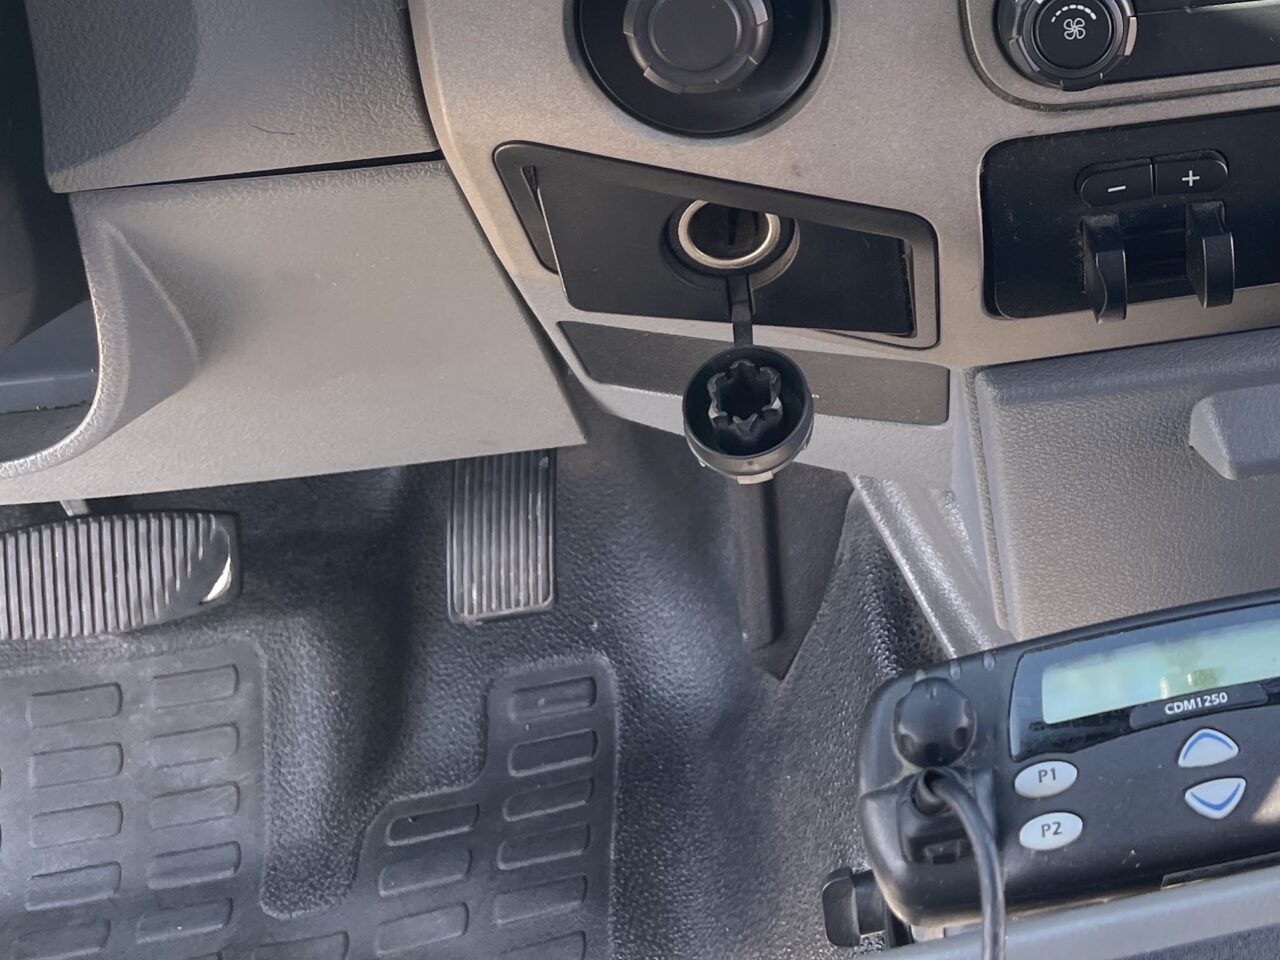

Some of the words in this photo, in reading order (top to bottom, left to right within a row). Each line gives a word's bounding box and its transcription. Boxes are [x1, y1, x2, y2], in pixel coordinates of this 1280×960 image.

[1164, 691, 1228, 715] CDM1250
[1038, 767, 1057, 783] P1
[1041, 821, 1063, 838] P2
